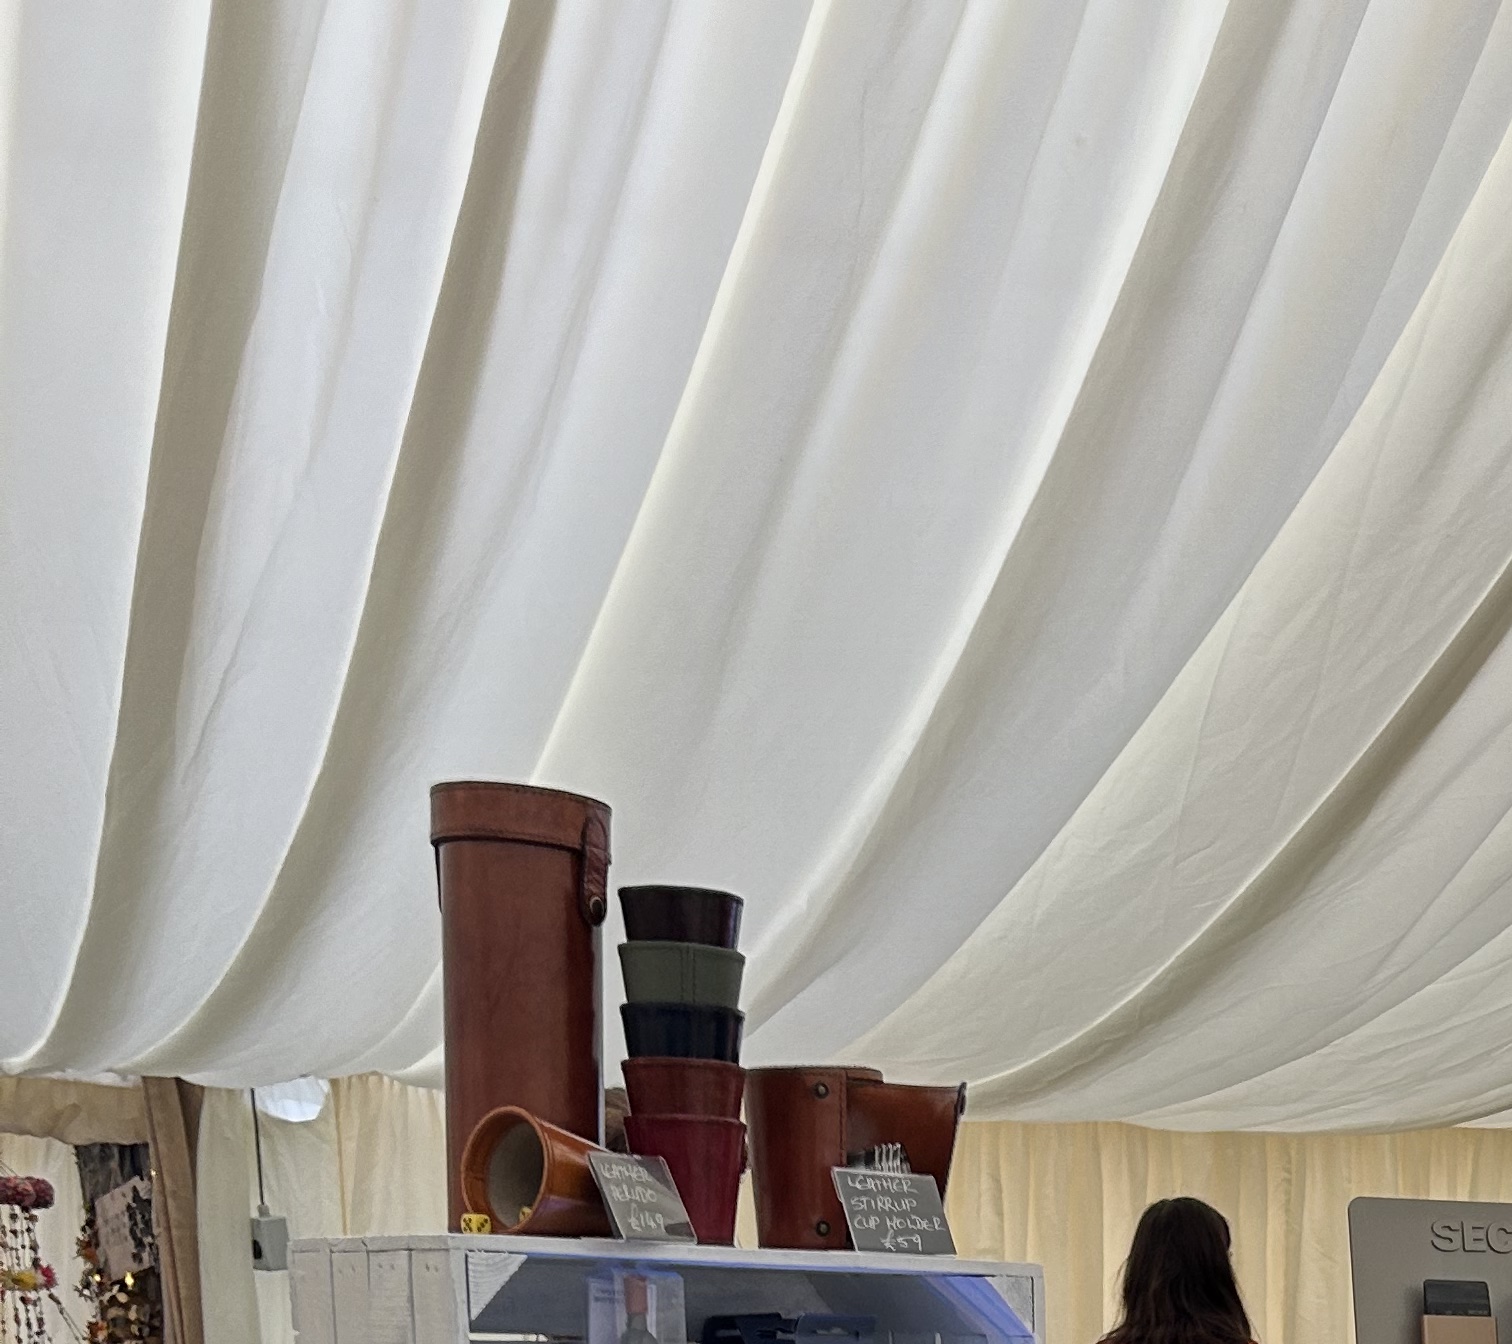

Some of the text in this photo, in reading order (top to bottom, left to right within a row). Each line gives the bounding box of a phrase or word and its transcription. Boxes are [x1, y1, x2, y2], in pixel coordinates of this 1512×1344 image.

[847, 1175, 918, 1194] LEATHER
[850, 1196, 917, 1212] STIRRUP
[854, 1214, 946, 1231] CUP HOLDER
[881, 1230, 922, 1252] £59
